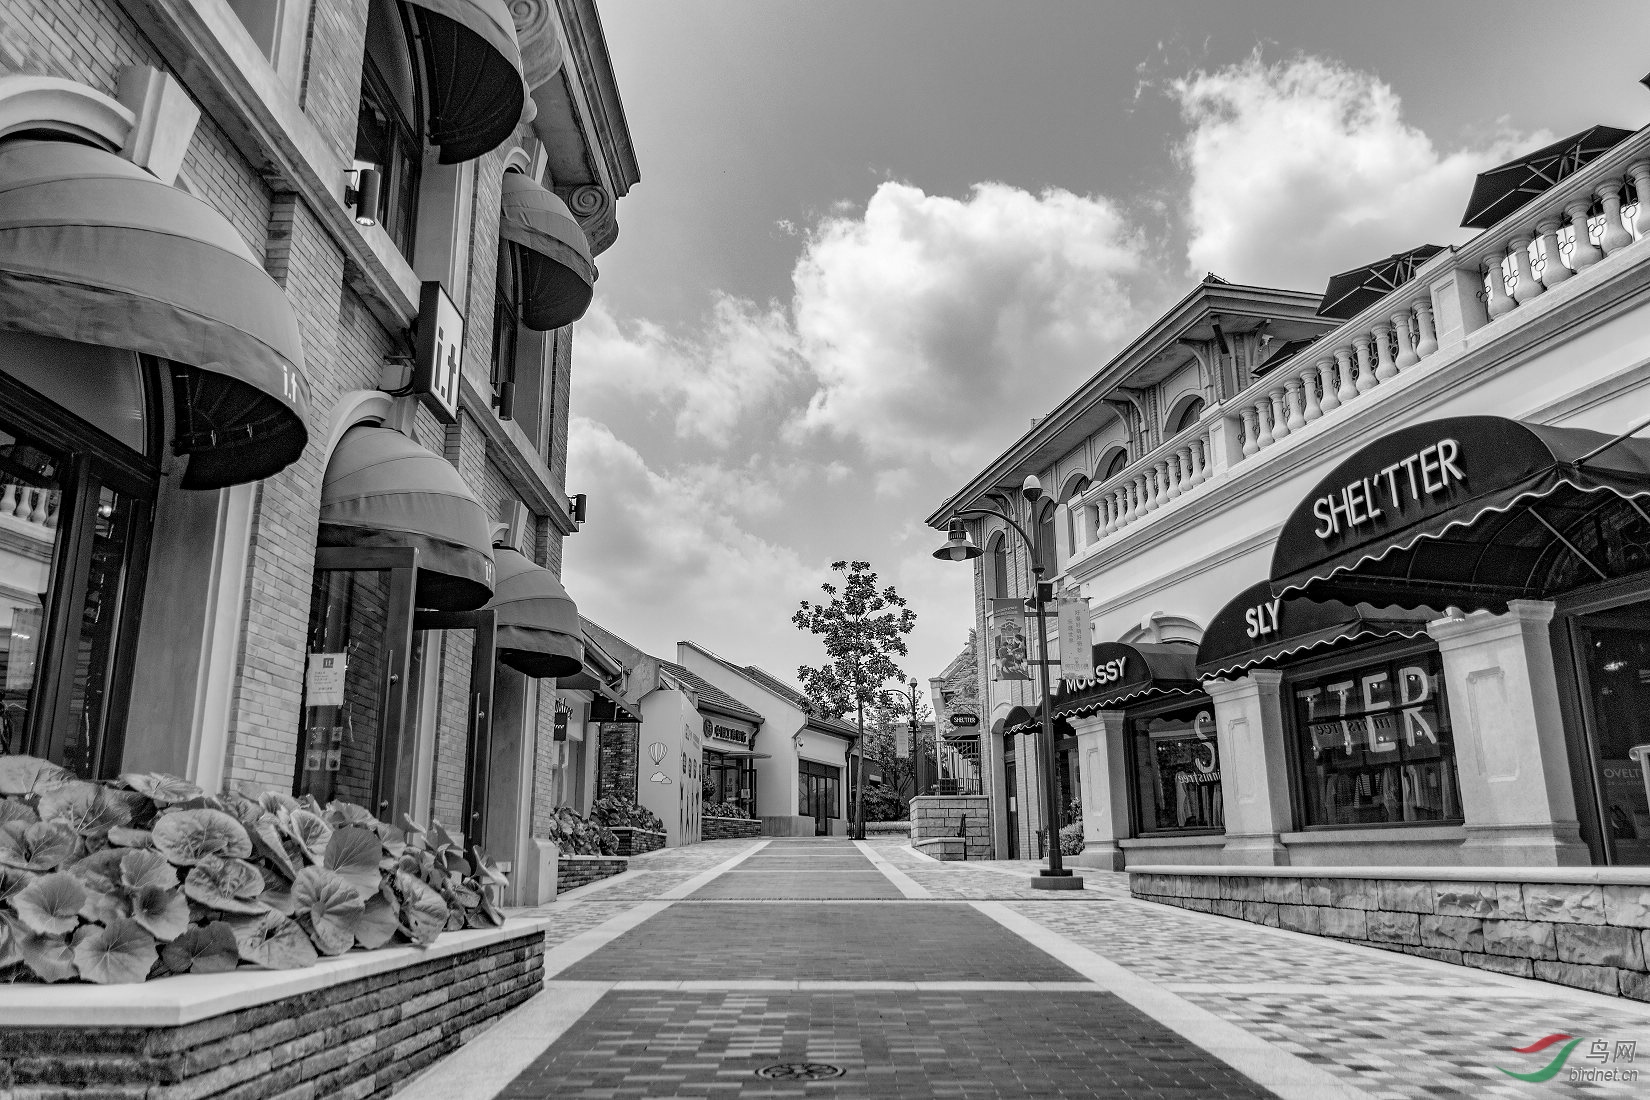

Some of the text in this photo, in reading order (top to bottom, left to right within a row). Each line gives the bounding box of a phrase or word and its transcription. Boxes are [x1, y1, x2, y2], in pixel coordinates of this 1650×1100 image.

[282, 364, 298, 403] i.t
[434, 326, 457, 406] i.t
[1245, 598, 1281, 638] SLY
